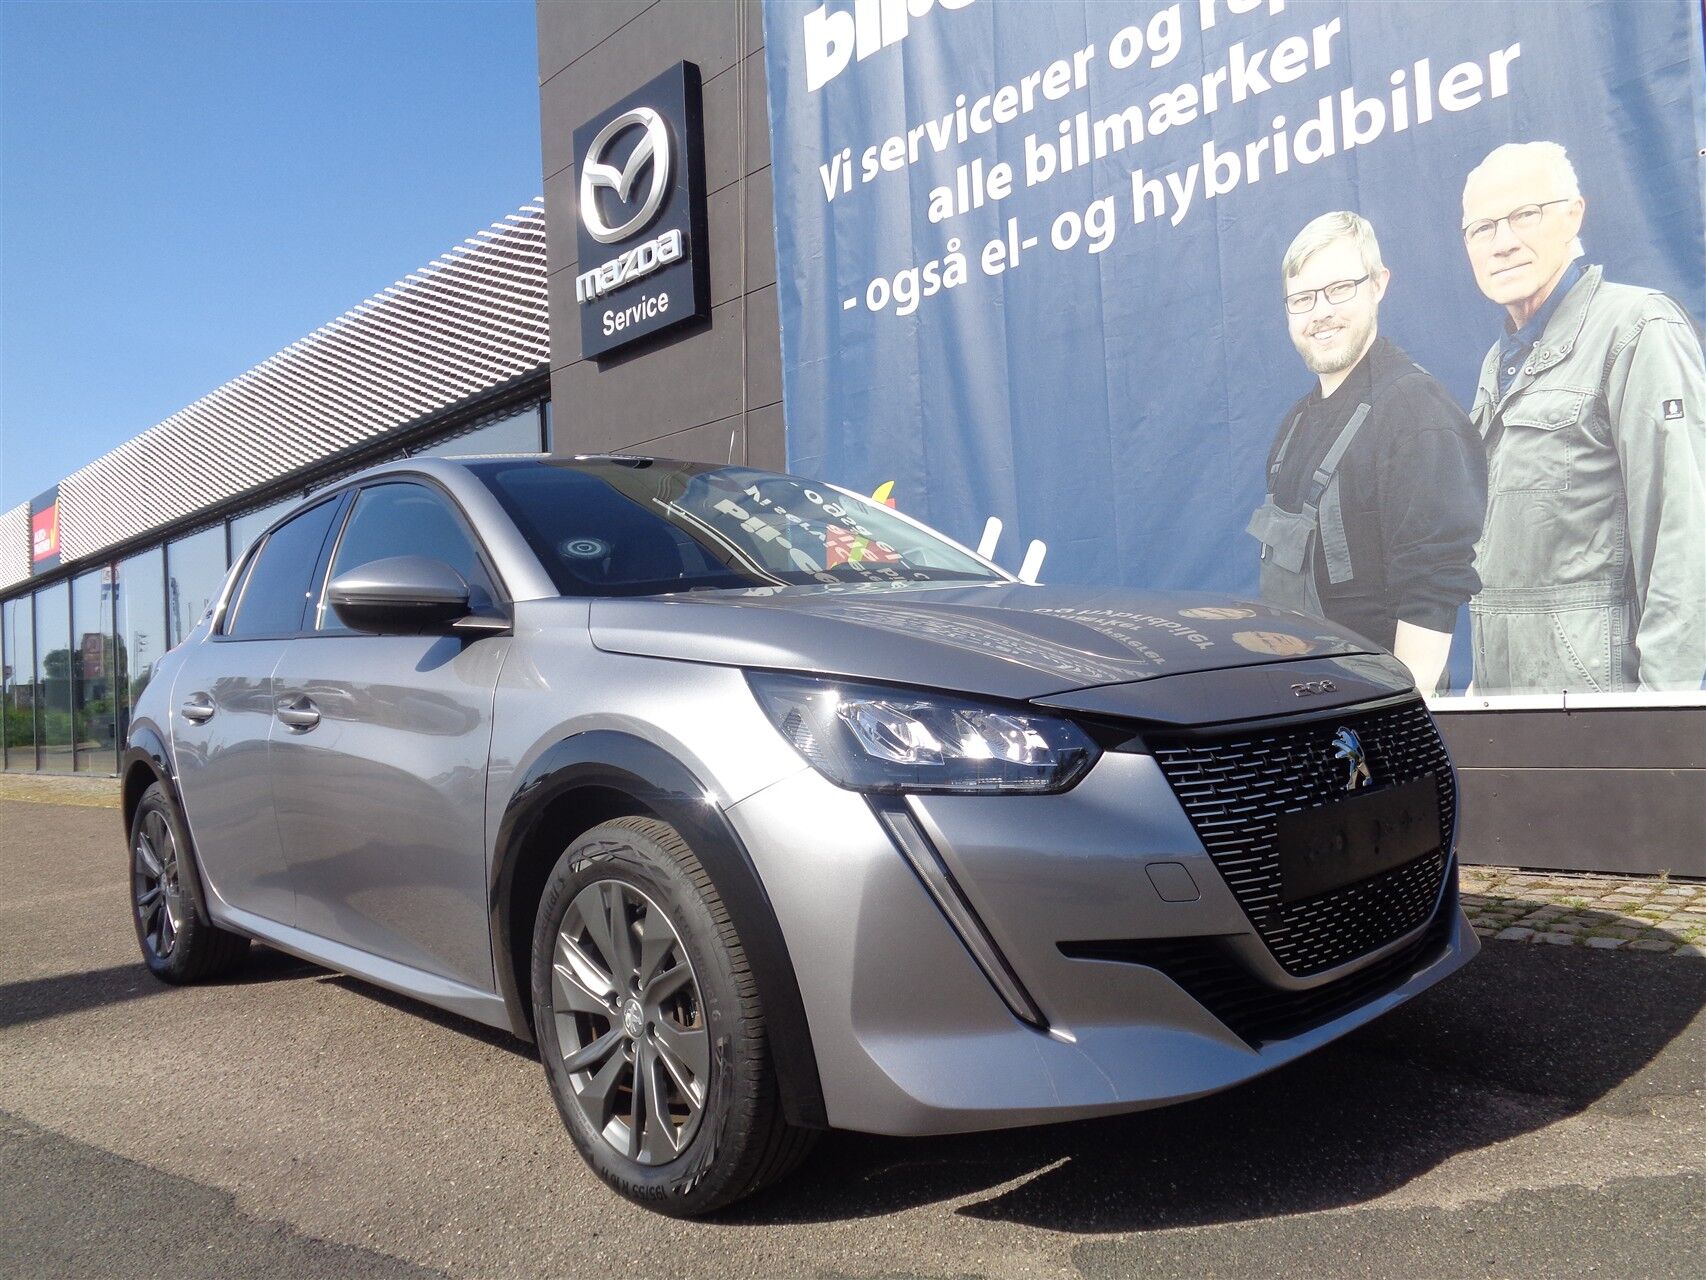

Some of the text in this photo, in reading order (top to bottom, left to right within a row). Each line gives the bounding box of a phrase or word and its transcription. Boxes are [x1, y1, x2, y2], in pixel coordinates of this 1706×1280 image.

[819, 147, 852, 202] Vi
[861, 43, 1095, 183] servicerer
[1108, 3, 1182, 69] og
[866, 237, 968, 316] også
[981, 218, 1038, 276] el-
[1051, 195, 1116, 254] og
[1132, 42, 1521, 228] hybridbiler
[928, 17, 1341, 223] alle bilmærker
[603, 291, 669, 336] Service
